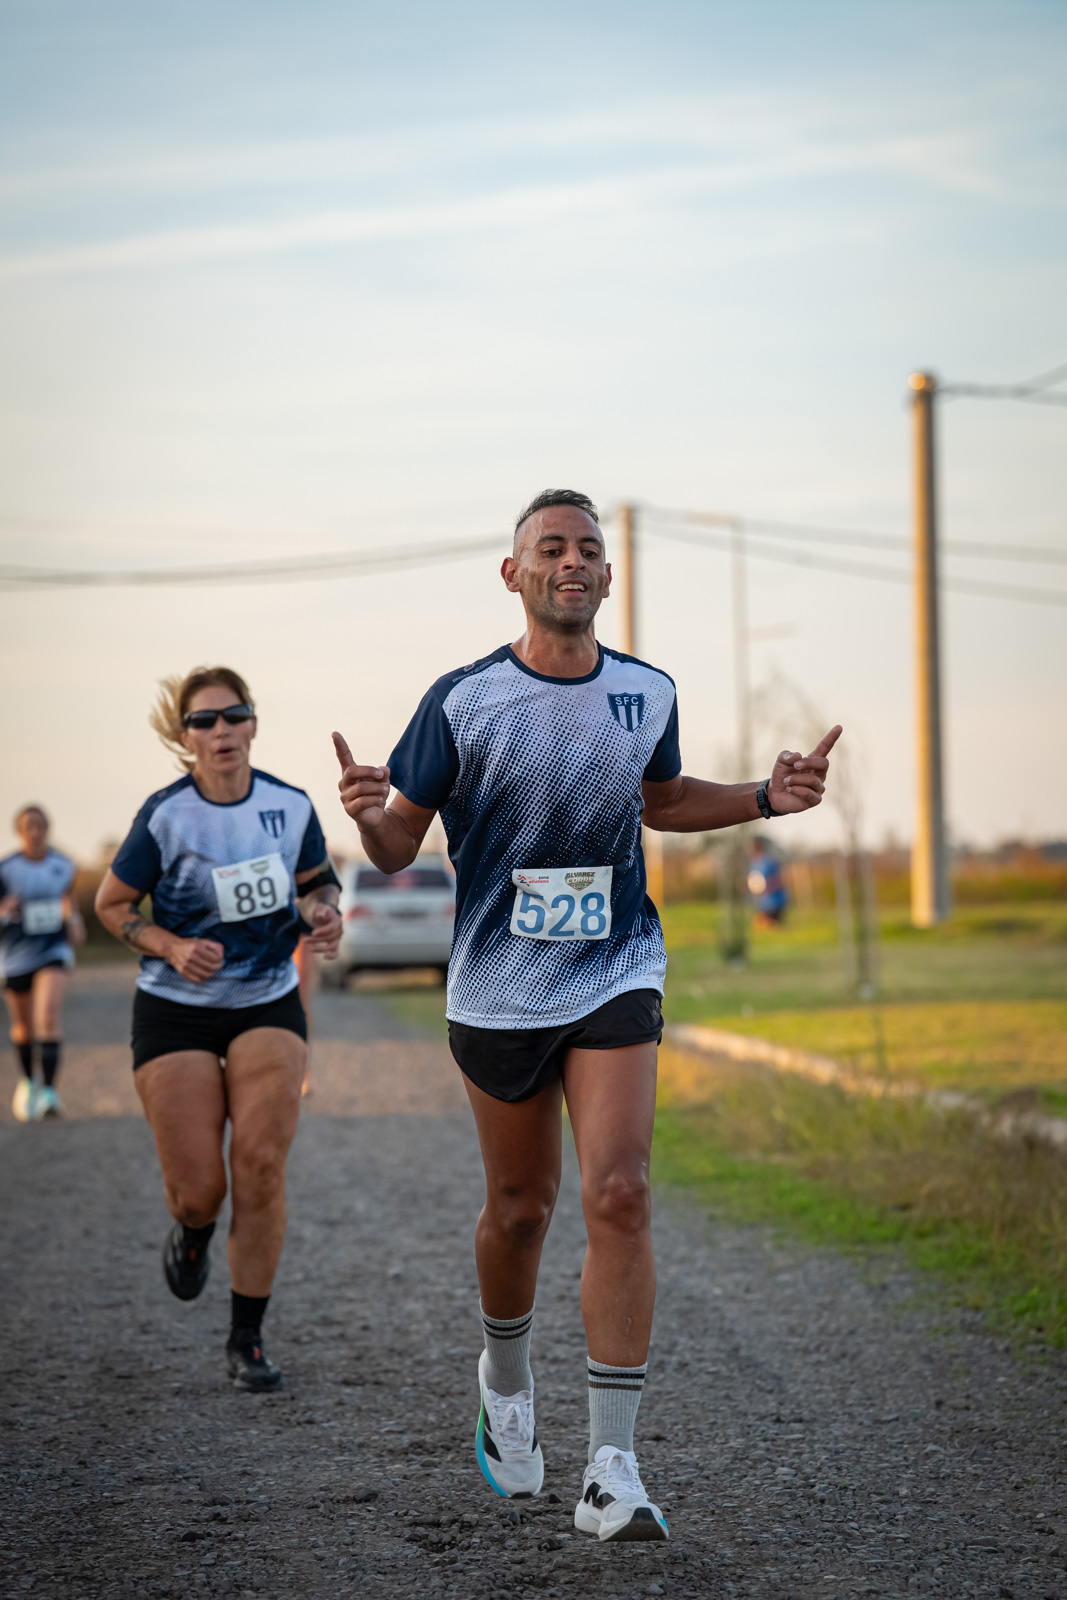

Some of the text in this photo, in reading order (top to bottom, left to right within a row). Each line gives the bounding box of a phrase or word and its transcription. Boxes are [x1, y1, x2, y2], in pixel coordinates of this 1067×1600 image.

[615, 696, 639, 705] SFC
[234, 876, 277, 915] 89
[517, 891, 607, 936] 528
